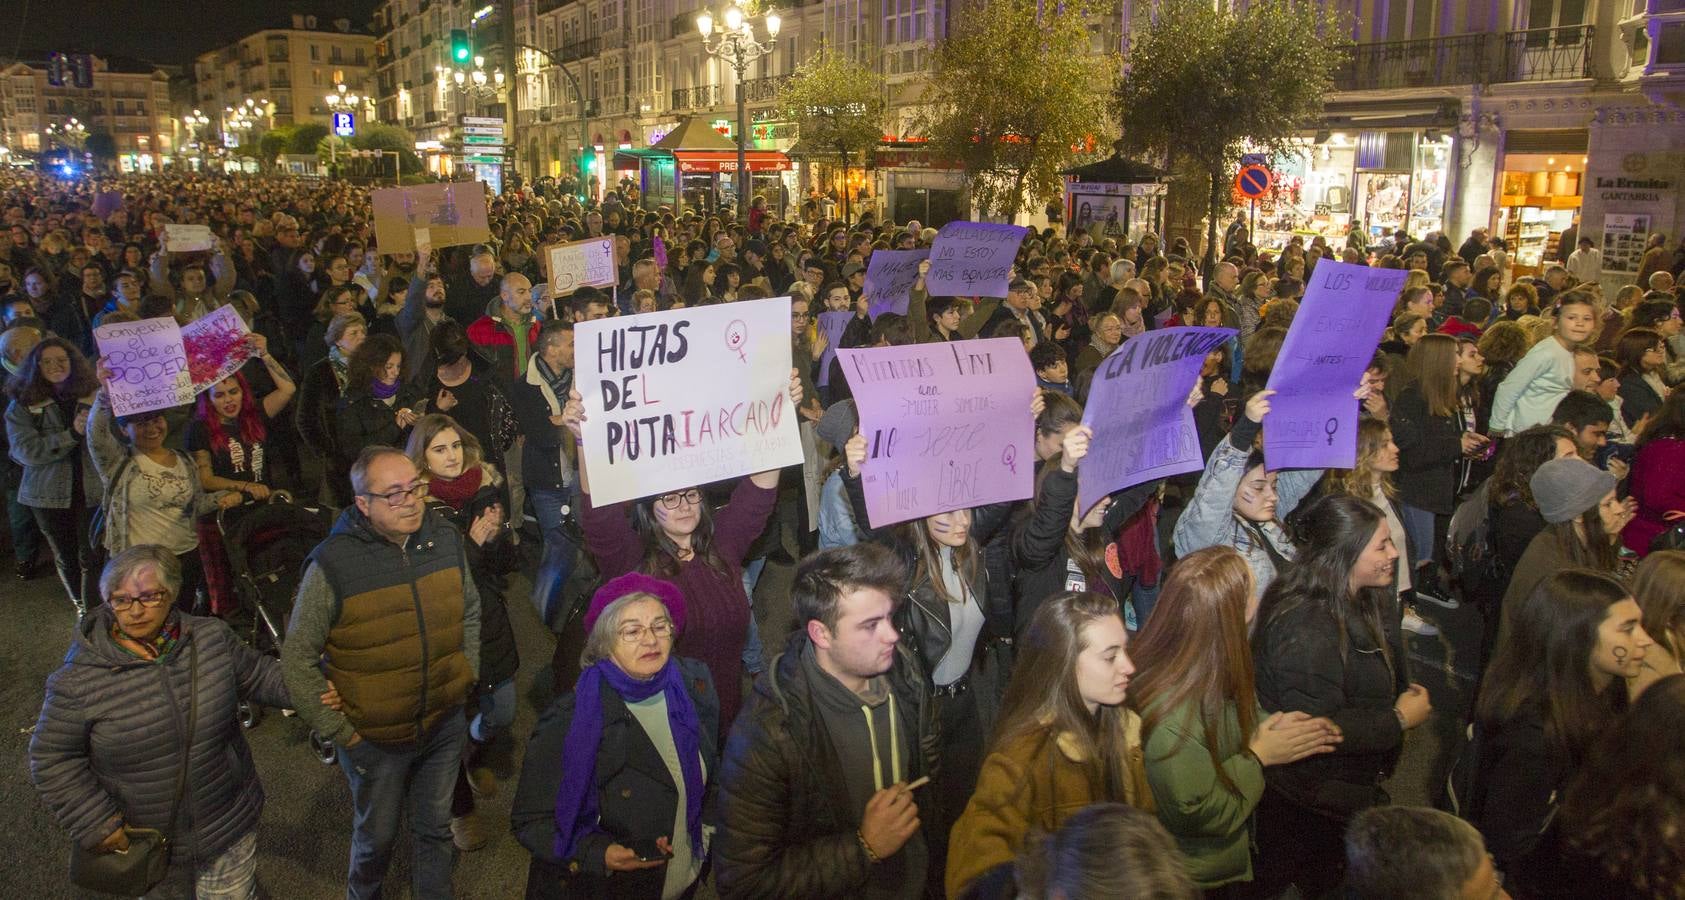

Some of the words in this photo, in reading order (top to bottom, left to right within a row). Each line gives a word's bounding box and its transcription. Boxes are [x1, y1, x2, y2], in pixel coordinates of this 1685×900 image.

[719, 162, 751, 171] PRENA
[1597, 177, 1614, 188] La
[1616, 177, 1669, 189] Ermita
[1601, 191, 1660, 202] CANTABRIA
[942, 227, 1016, 242] CALLADITA
[939, 246, 955, 260] NO
[963, 246, 999, 261] ESTOY
[961, 266, 1007, 282] BONITA
[1324, 272, 1353, 290] LOS
[128, 335, 146, 350] el
[164, 343, 184, 354] en
[598, 320, 690, 373] HIJAS
[1104, 341, 1138, 381] LA
[1140, 332, 1230, 370] VIOLENCIA
[108, 357, 190, 387] PODER
[851, 353, 935, 383] MIENTRAS
[601, 373, 661, 412] DEL
[917, 384, 942, 396] una
[906, 398, 940, 416] MUJER
